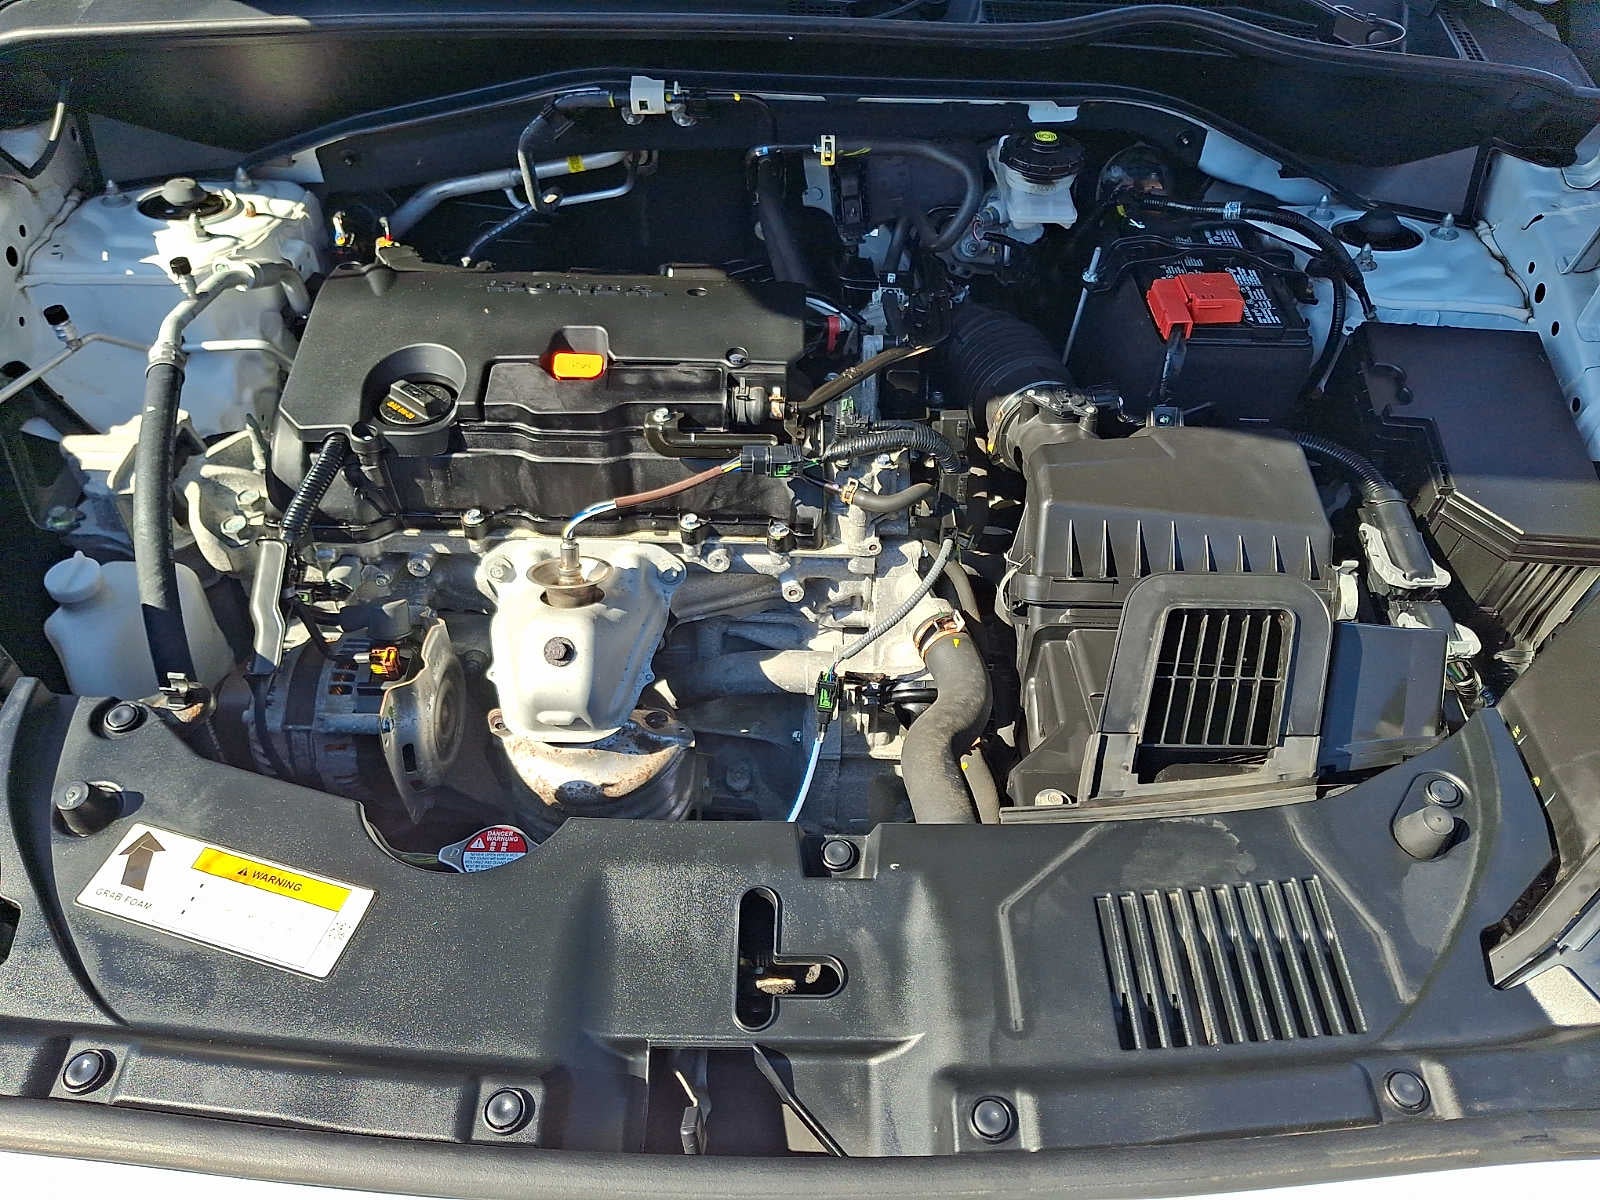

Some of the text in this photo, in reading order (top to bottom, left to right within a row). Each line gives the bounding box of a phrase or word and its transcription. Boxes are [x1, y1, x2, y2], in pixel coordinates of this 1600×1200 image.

[252, 871, 303, 891] WARNING
[95, 888, 153, 910] GRAB FOAM
